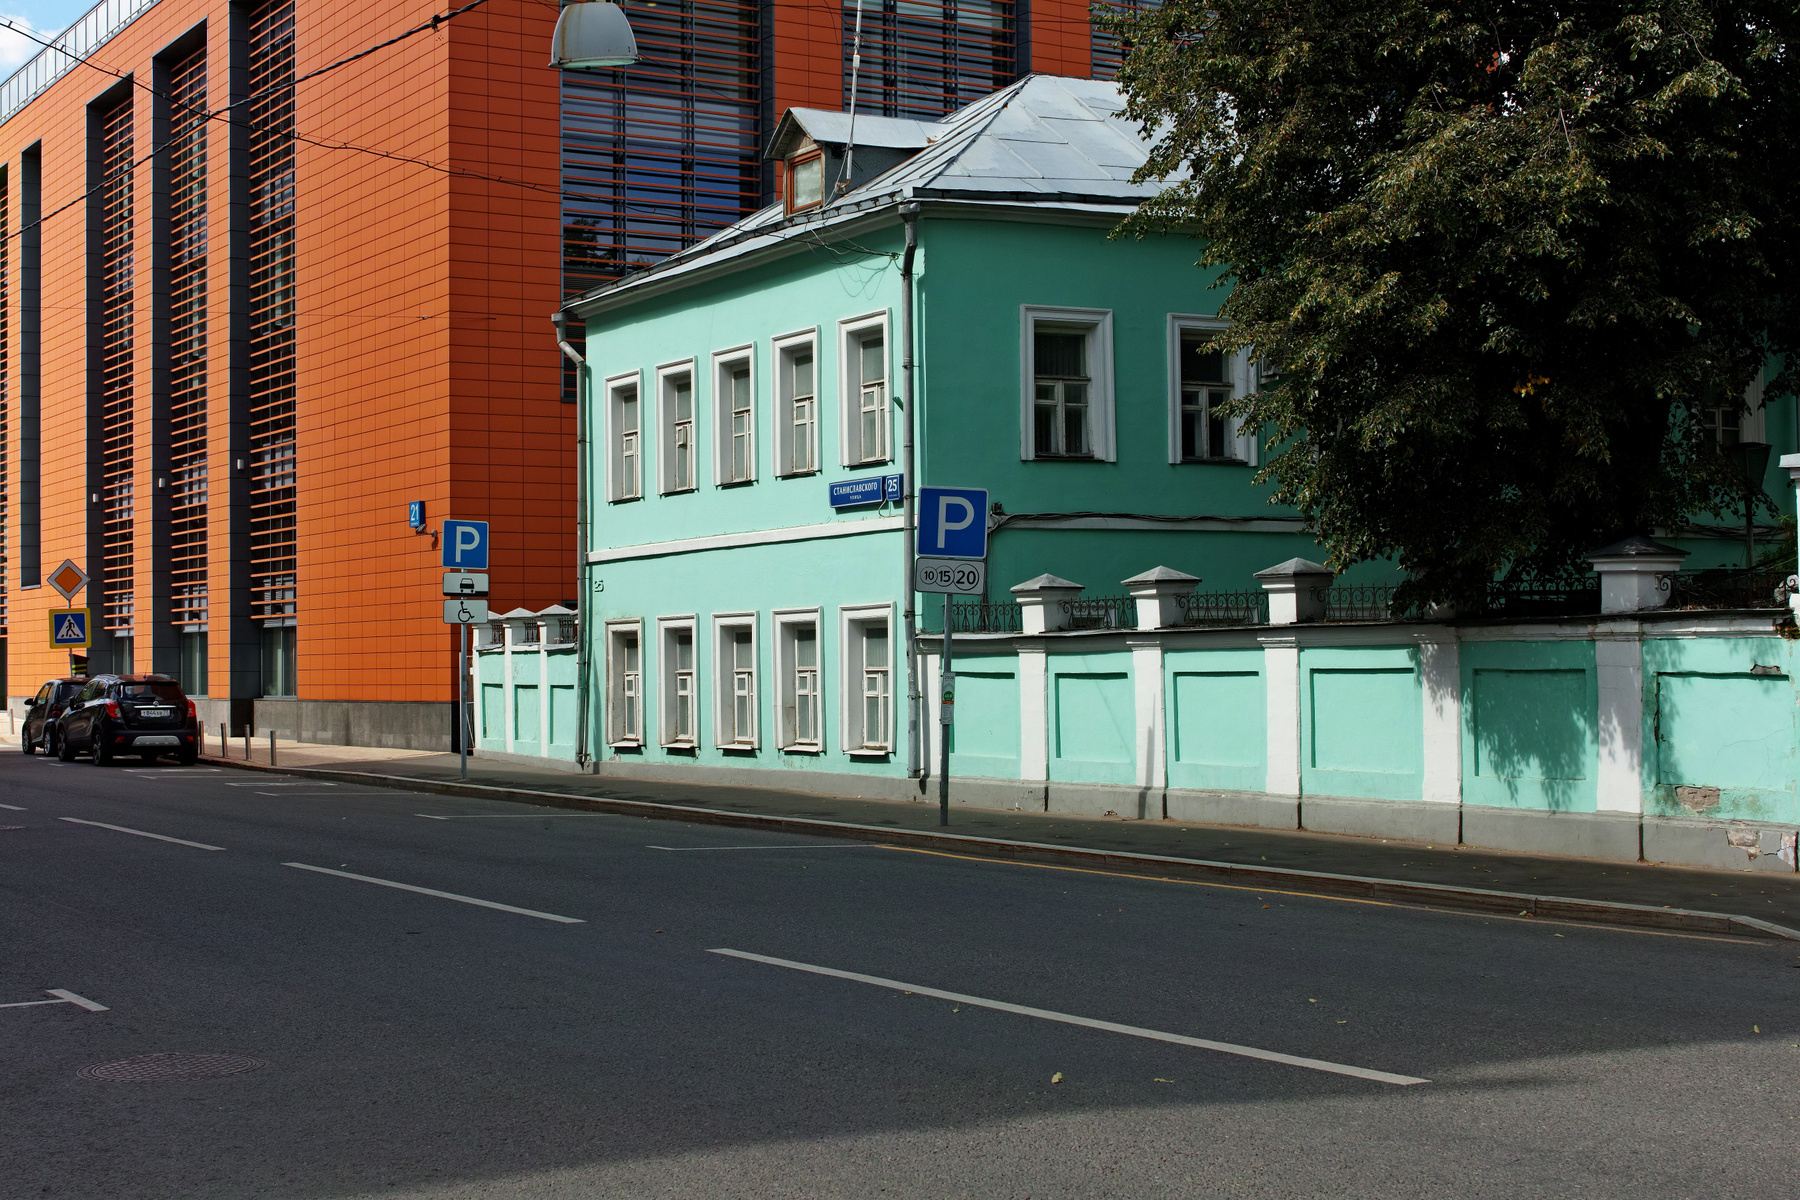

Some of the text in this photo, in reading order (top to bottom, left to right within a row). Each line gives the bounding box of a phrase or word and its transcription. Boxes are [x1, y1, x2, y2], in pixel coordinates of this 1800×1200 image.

[833, 482, 878, 495] СТАНИСЛАВСКОГО
[887, 479, 898, 492] 25
[410, 504, 419, 521] 21
[937, 495, 975, 549] P
[455, 526, 480, 563] P
[924, 570, 976, 584] 10 15 20
